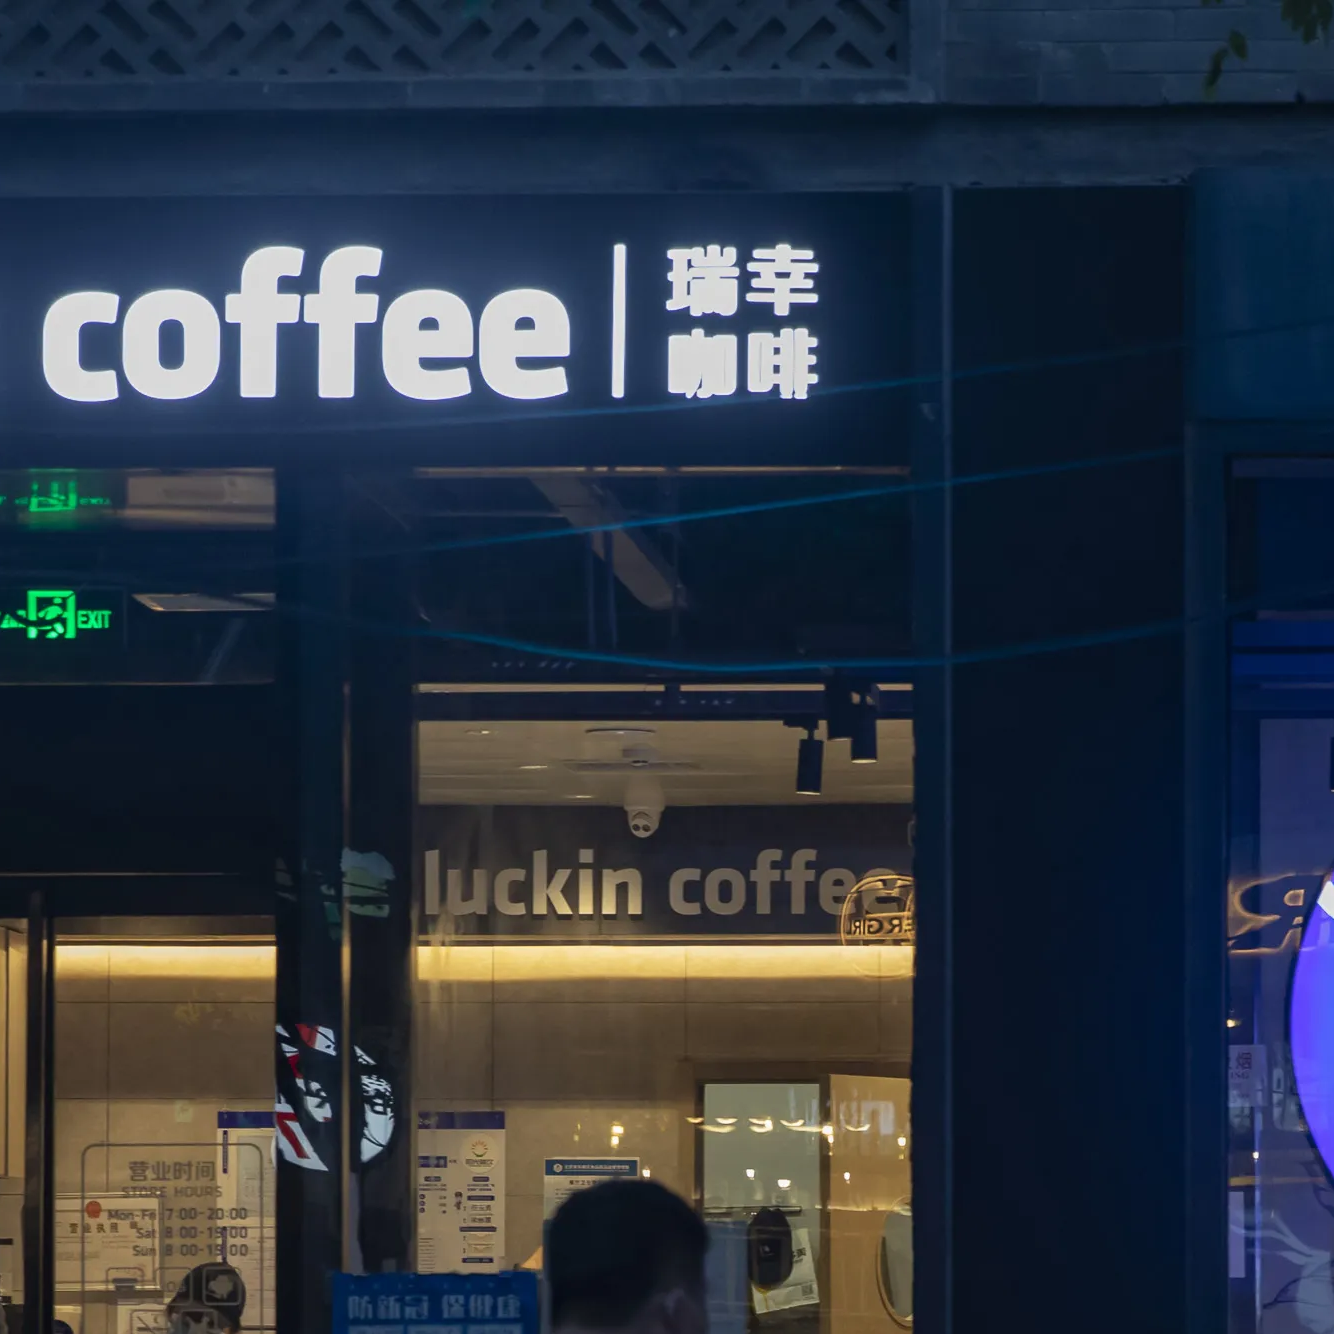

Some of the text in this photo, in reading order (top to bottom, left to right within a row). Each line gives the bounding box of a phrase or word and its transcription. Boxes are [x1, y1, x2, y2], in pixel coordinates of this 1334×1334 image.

[665, 243, 820, 318] 瑞幸
[42, 245, 571, 402] coffee
[665, 327, 820, 400] 咖啡
[77, 610, 112, 629] EXIT
[424, 848, 905, 916] luckin coffee
[121, 1186, 223, 1198] STORE HOURS
[128, 1160, 216, 1181] 营业时间
